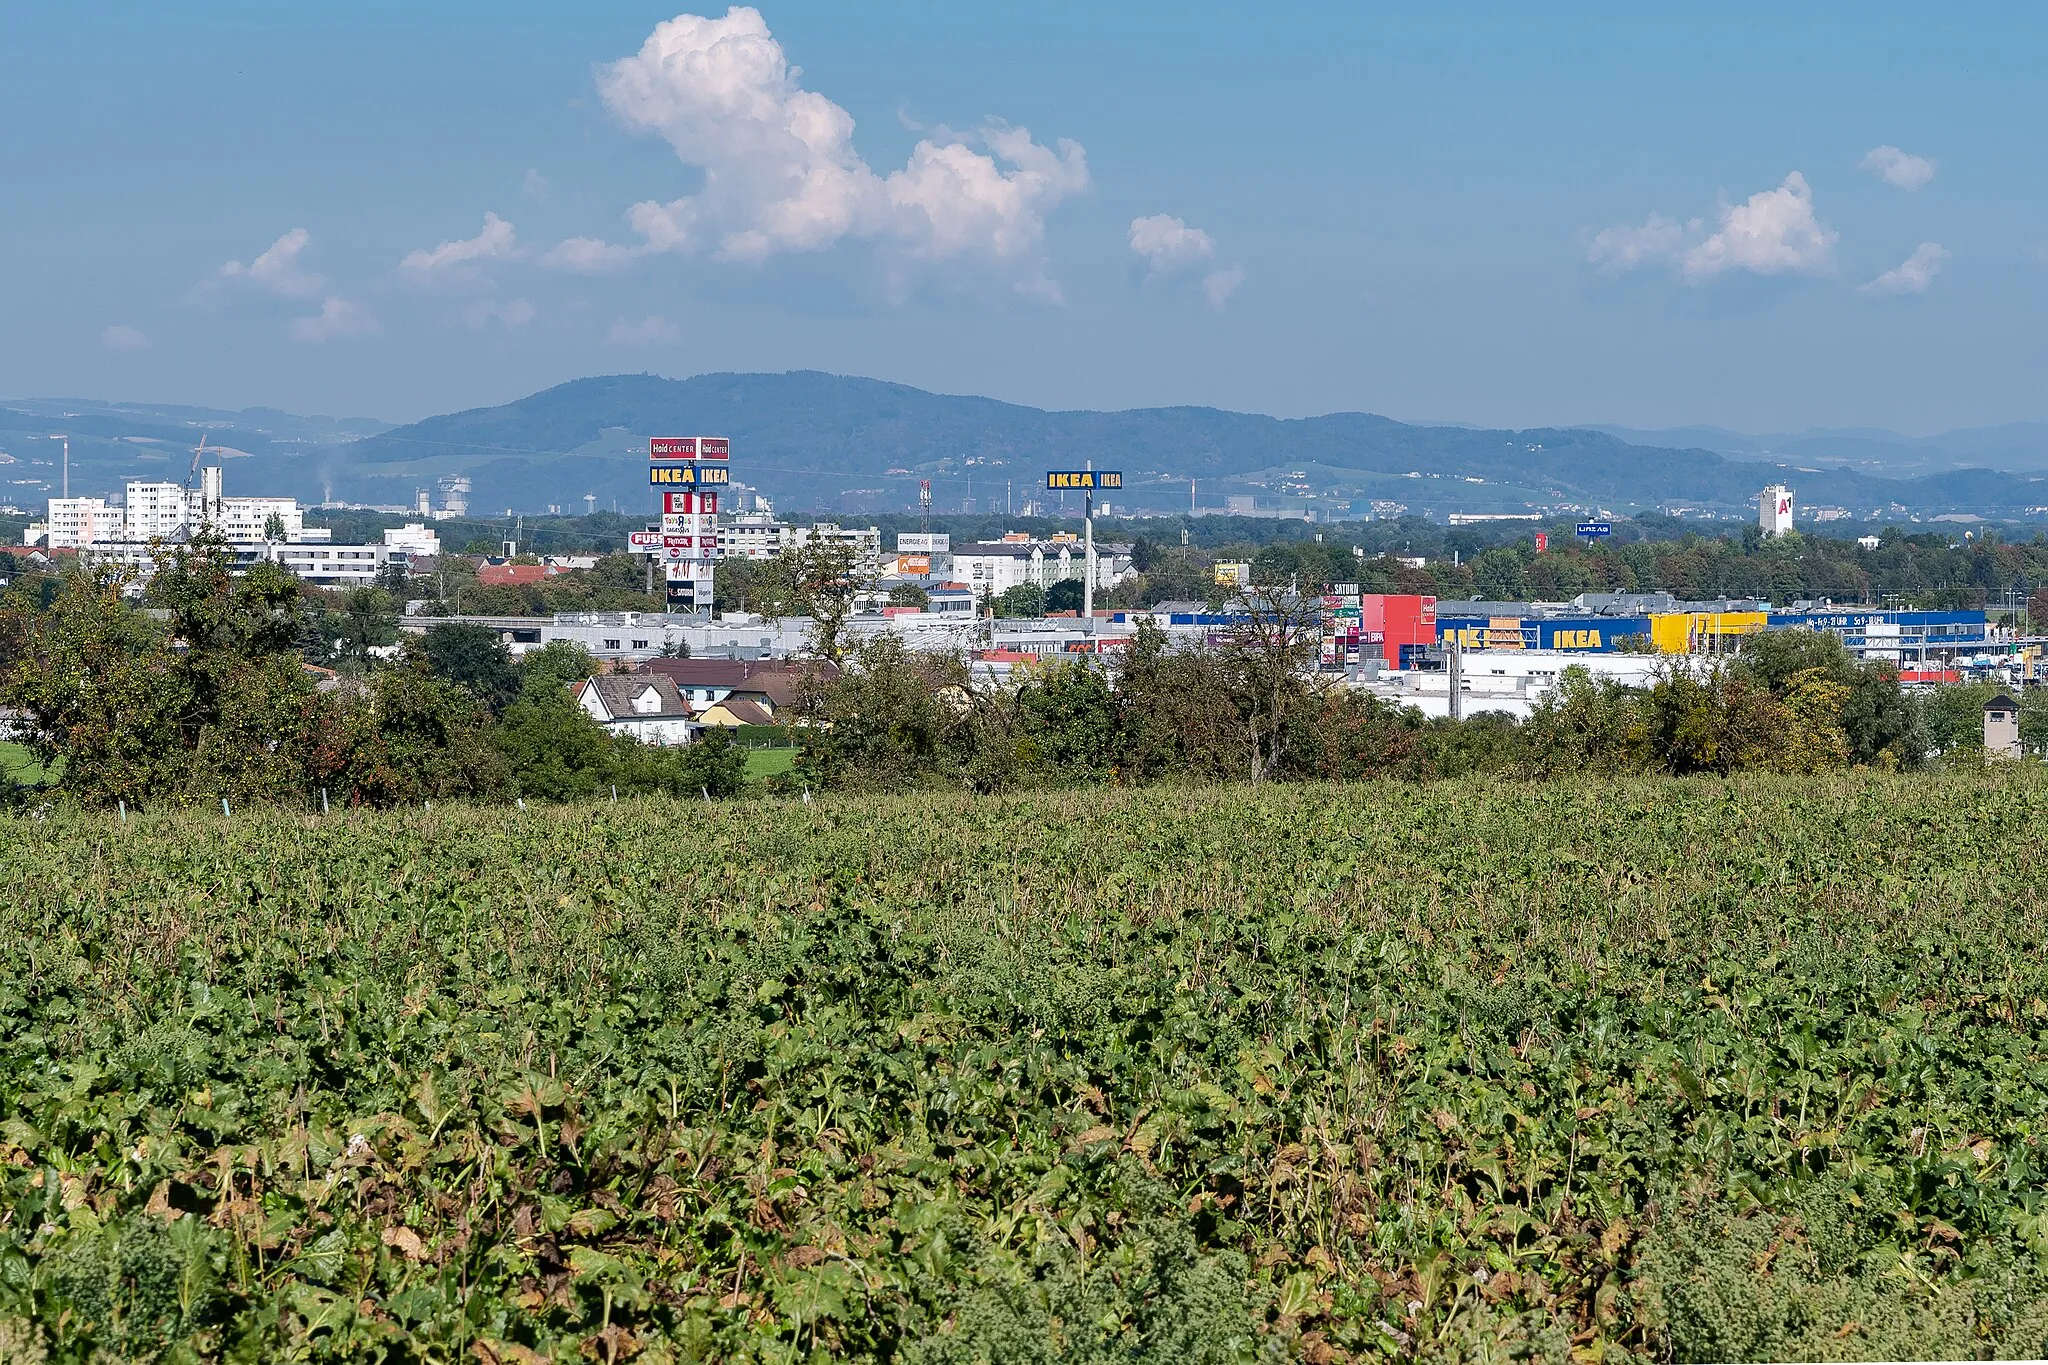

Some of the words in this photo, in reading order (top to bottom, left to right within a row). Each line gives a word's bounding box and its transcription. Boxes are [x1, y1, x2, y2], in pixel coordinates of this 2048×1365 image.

[653, 444, 668, 453] Haid
[651, 469, 695, 483] IKEA
[701, 469, 728, 483] IKEA
[1049, 474, 1094, 487] IKEA
[1101, 474, 1121, 487] IKEA
[1778, 497, 1791, 515] A1
[1334, 583, 1359, 595] SATURN
[1370, 632, 1384, 642] BIPA
[1554, 630, 1602, 649] IKEA
